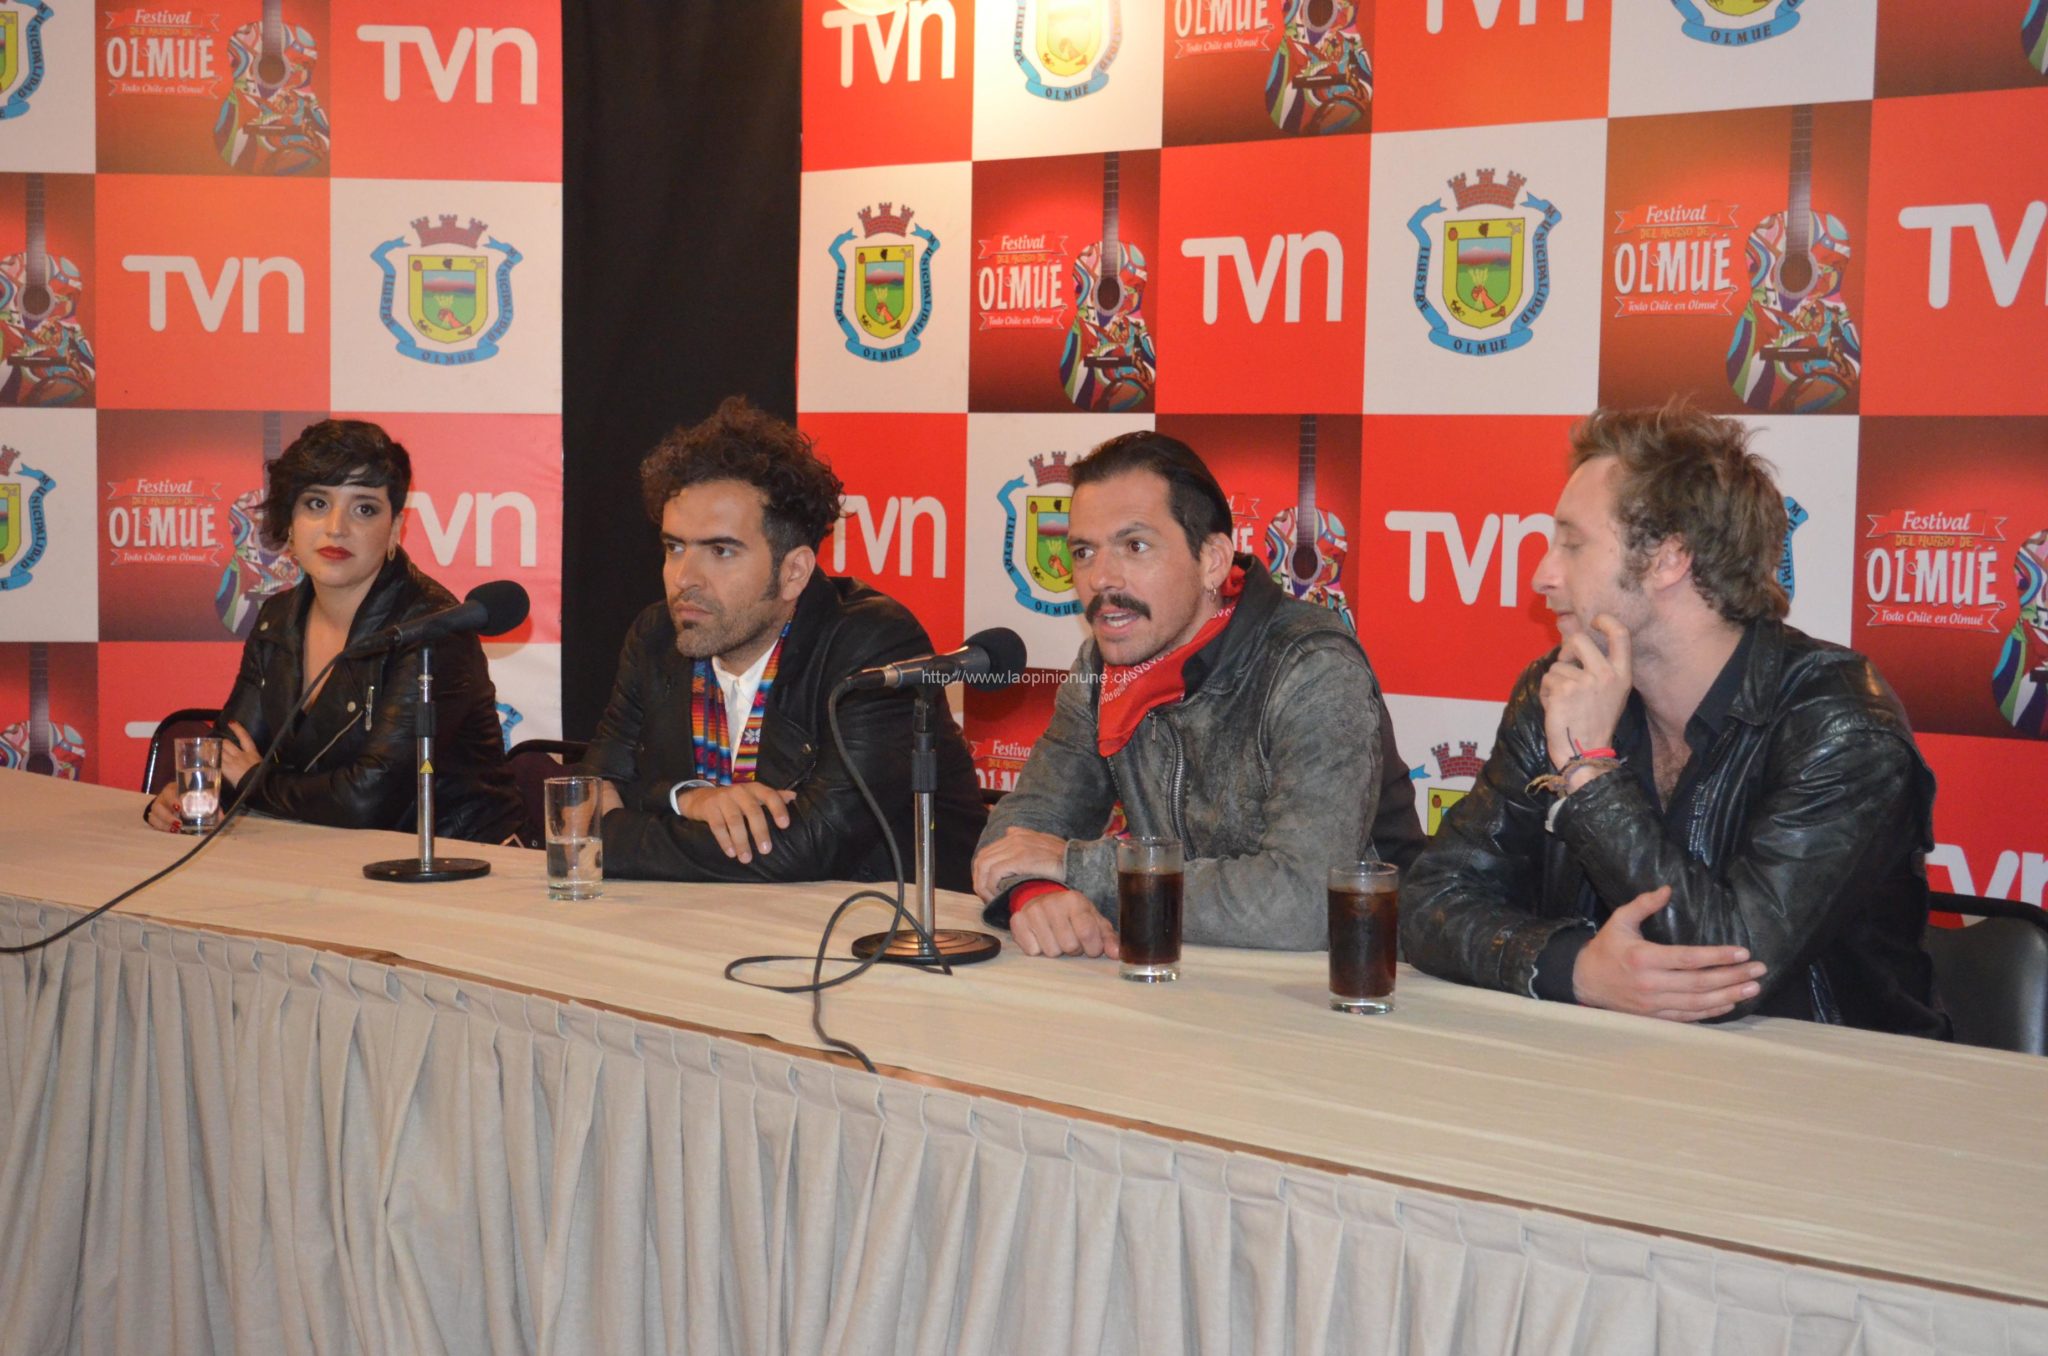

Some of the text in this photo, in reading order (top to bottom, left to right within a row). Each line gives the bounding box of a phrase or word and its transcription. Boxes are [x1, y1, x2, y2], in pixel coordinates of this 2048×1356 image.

[135, 9, 192, 24] Festival
[1711, 24, 1771, 45] OLMUE
[1646, 204, 1707, 223] Festival
[1001, 235, 1045, 251] Festival
[863, 347, 904, 361] OLMUE
[1454, 338, 1508, 355] OLMUE
[137, 479, 193, 494] Festival
[1902, 511, 1971, 531] Festival
[1035, 600, 1077, 616] OLMUE
[1882, 609, 1904, 621] Todo
[1906, 611, 1932, 624] Chile
[1935, 614, 1947, 624] en
[992, 740, 1031, 757] Festiva
